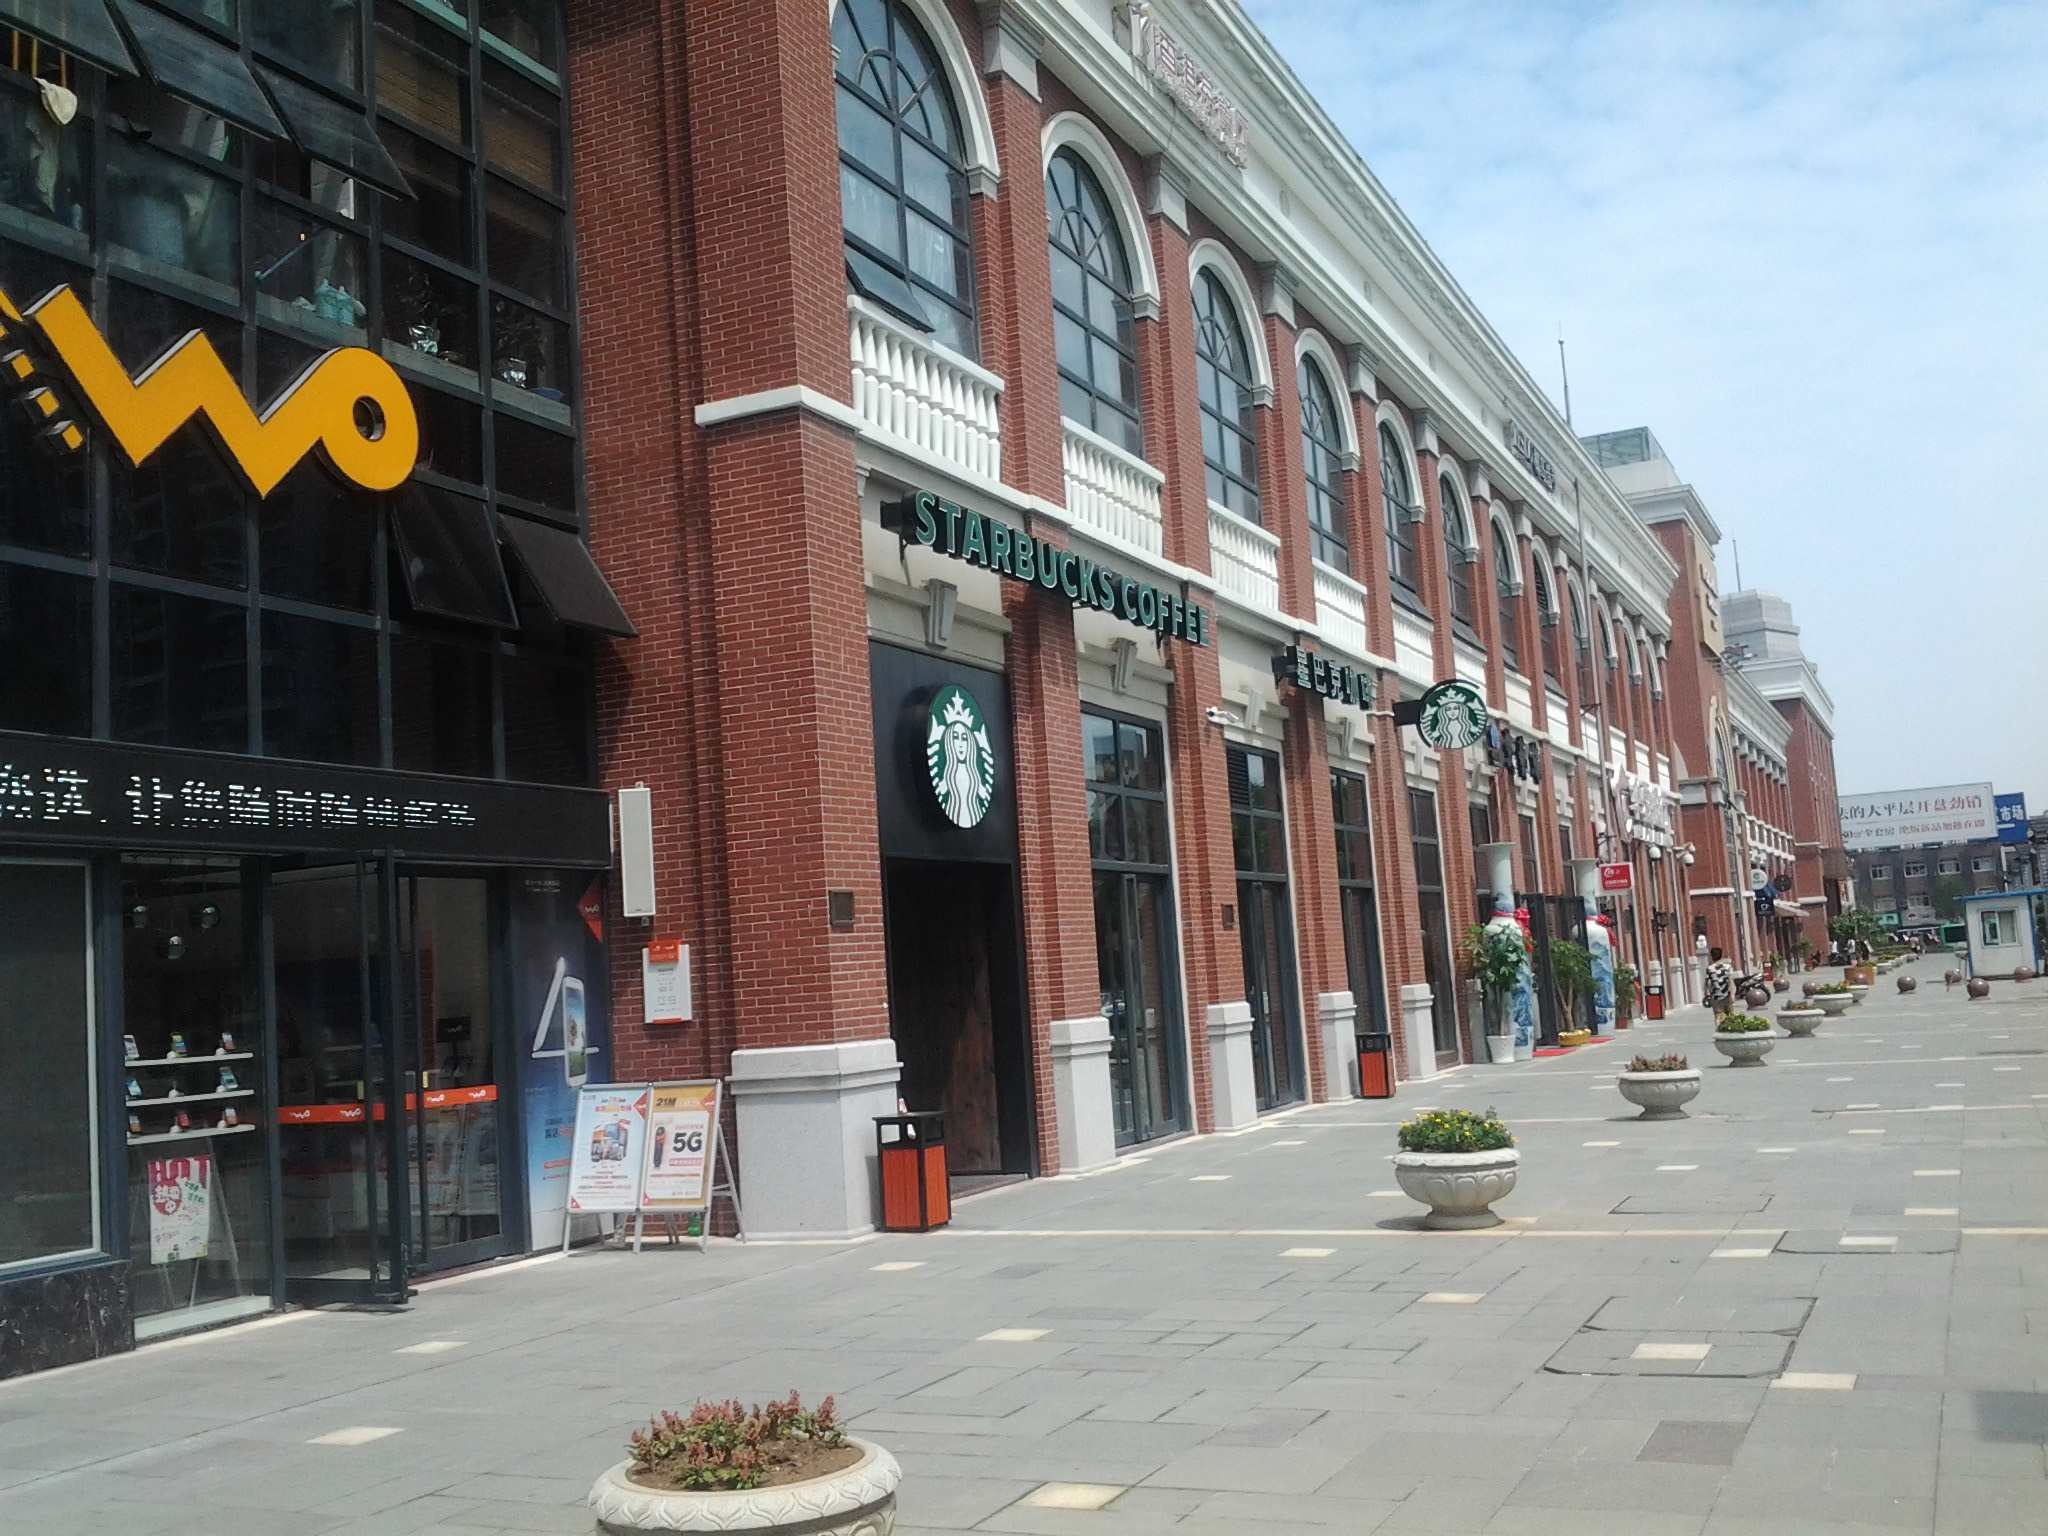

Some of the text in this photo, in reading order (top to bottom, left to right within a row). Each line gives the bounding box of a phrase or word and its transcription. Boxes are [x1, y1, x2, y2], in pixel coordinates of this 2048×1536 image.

[915, 490, 1211, 648] STARBUCKS COFFEE
[1995, 804, 2024, 823] 市场
[672, 1131, 703, 1152] 5G
